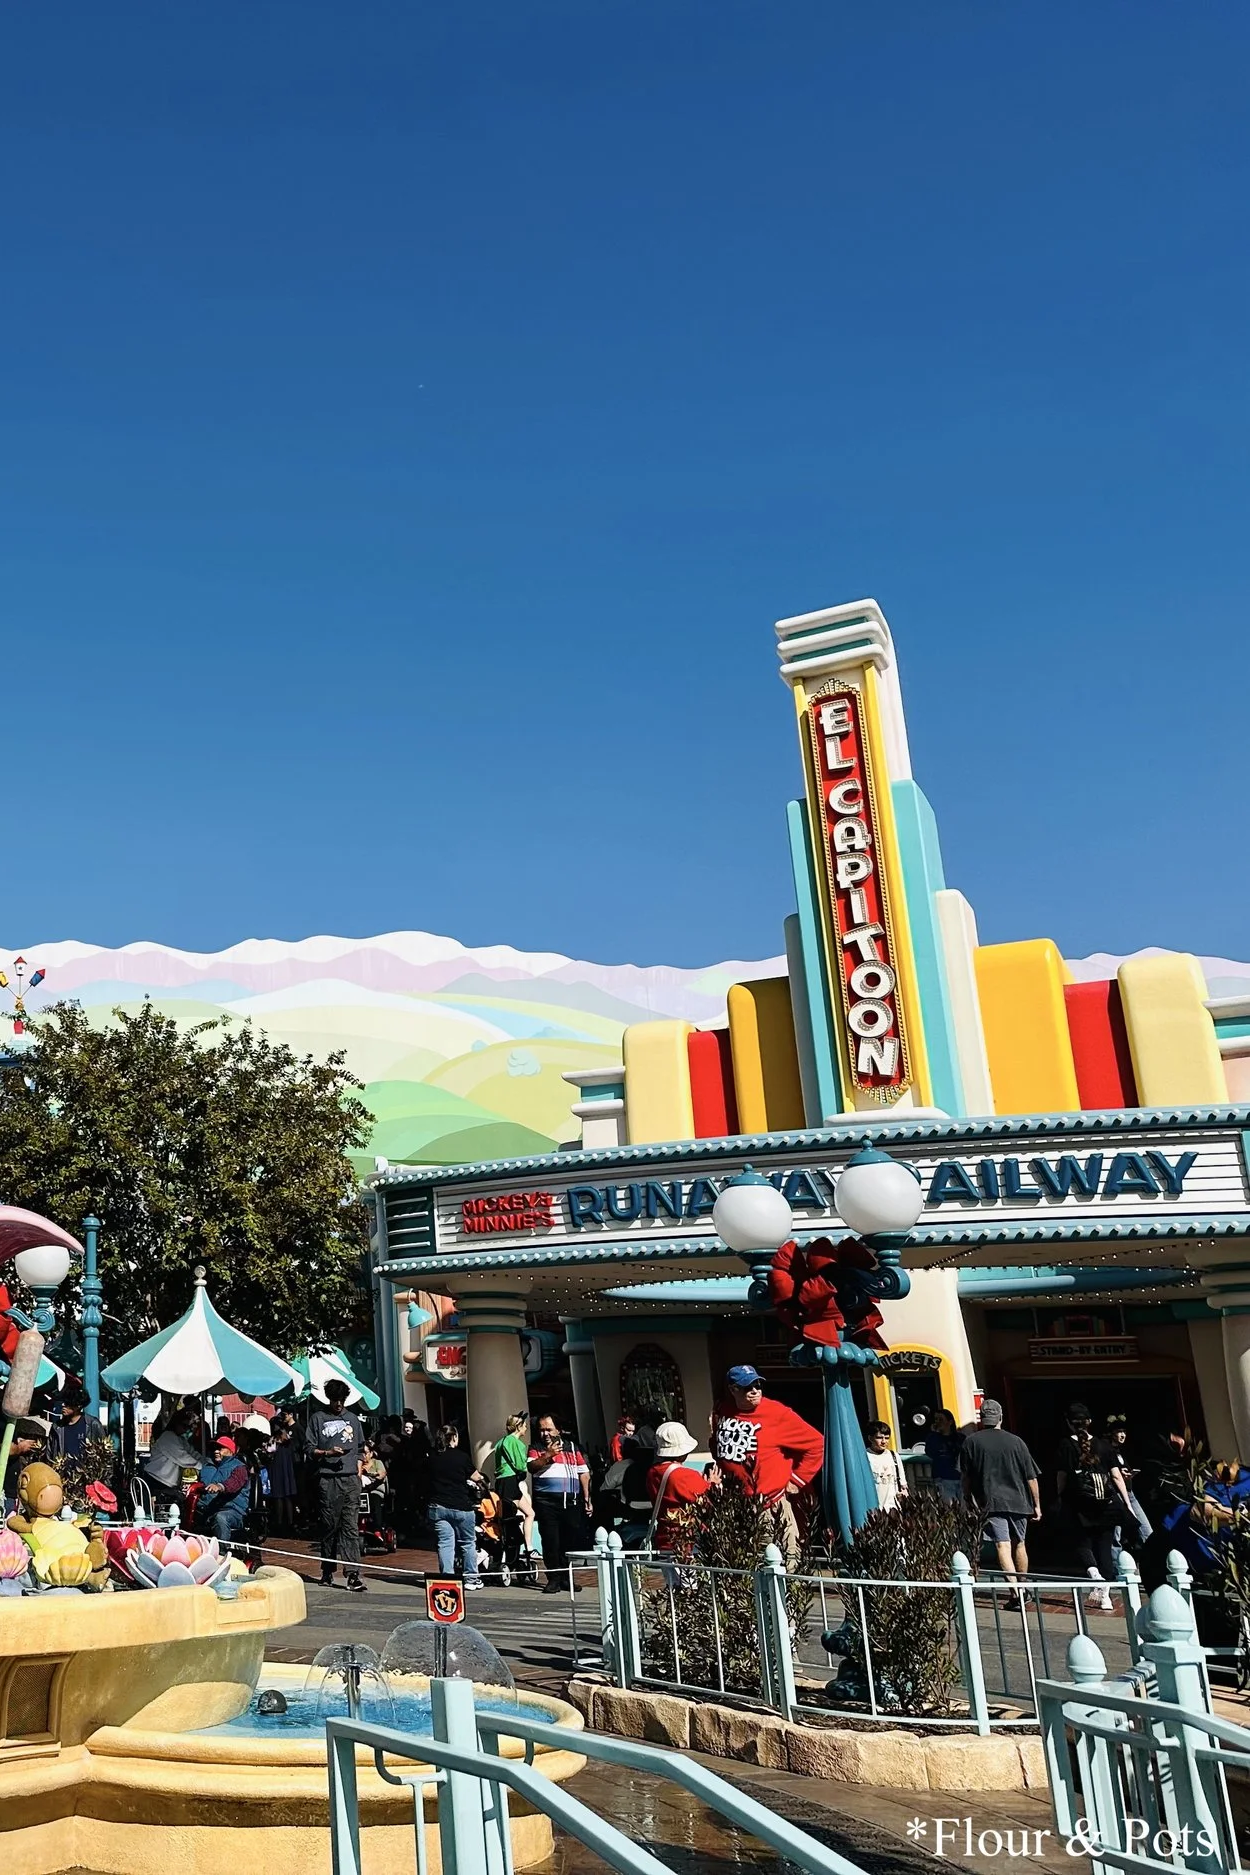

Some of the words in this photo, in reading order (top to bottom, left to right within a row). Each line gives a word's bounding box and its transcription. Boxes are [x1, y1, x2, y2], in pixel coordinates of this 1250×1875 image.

[819, 699, 857, 770] EL
[829, 778, 900, 1078] CAPITOON
[903, 1151, 1198, 1203] AILWAY
[463, 1211, 555, 1234] MINNIE'S
[1040, 1345, 1091, 1356] STAND-BY
[1094, 1344, 1126, 1355] ENTRY
